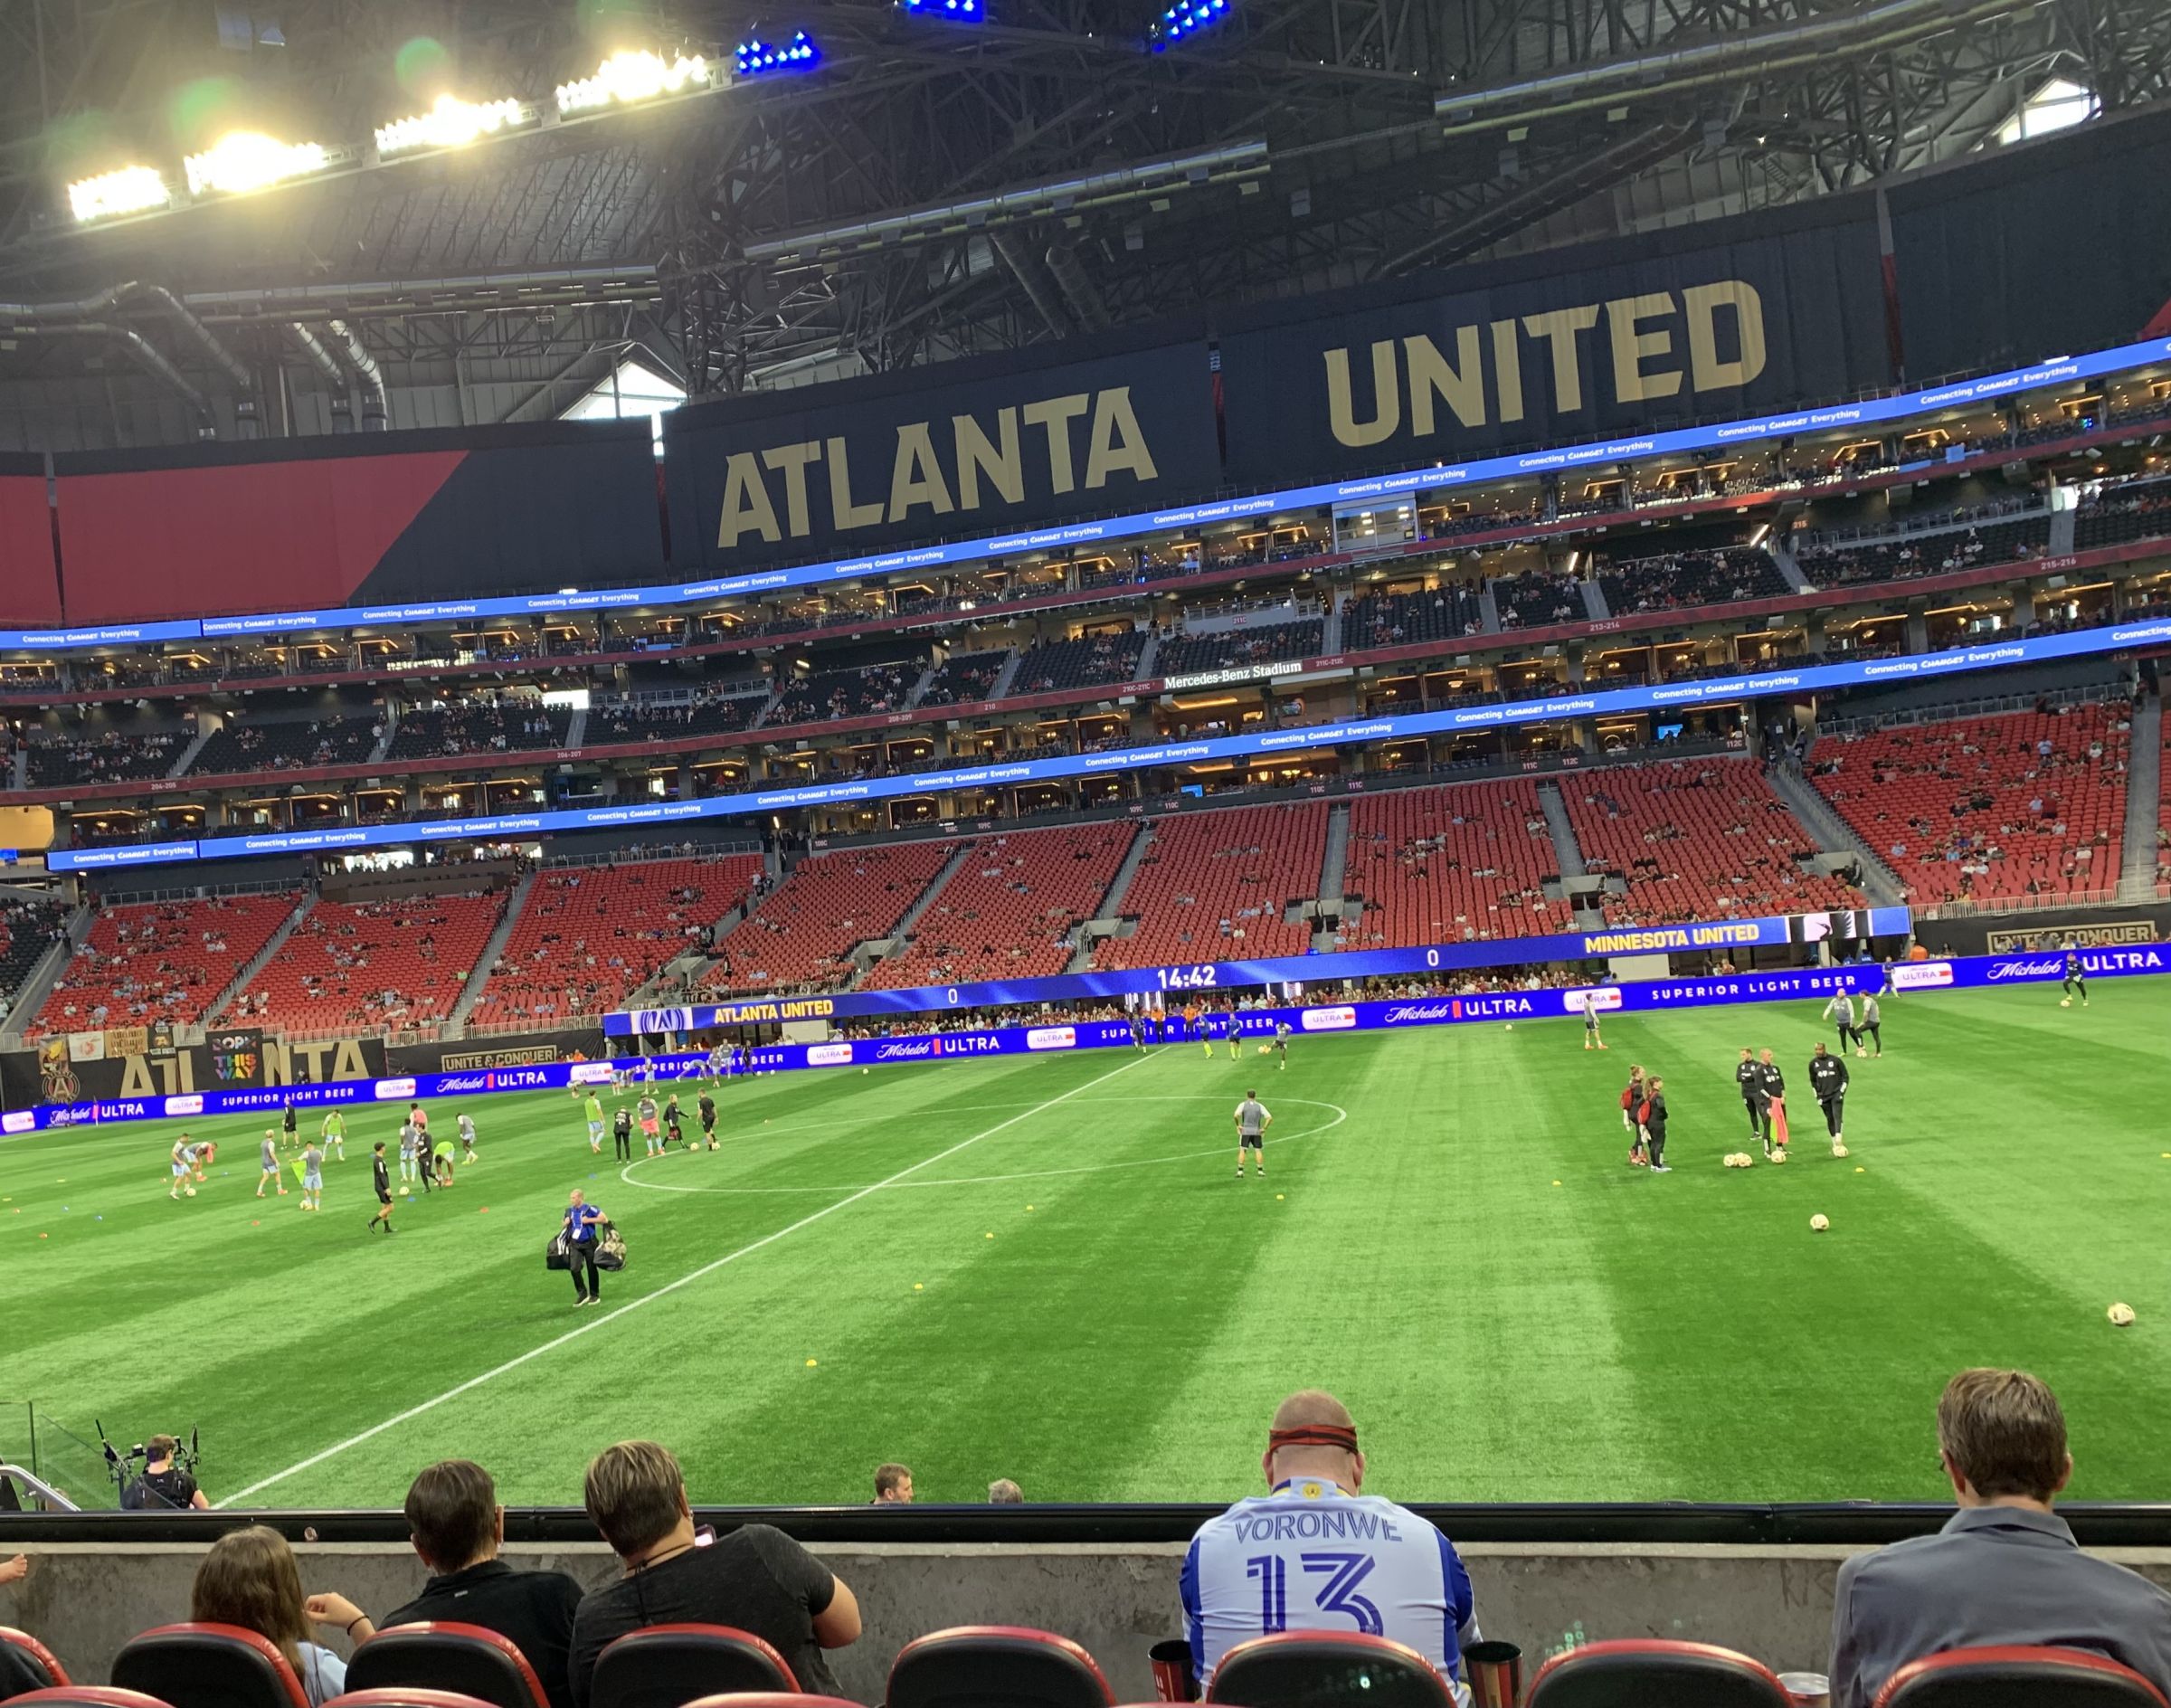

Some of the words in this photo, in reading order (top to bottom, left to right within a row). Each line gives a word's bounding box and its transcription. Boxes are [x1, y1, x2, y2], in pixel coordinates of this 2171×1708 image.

[1920, 387, 1974, 405] Connecting
[1975, 376, 2020, 393] CHANGES
[2022, 365, 2078, 383] Everything
[718, 386, 1159, 548] ATLANTA
[1323, 280, 1767, 447] UNITED
[1717, 423, 1767, 438] Connecting
[1768, 417, 1808, 431] CHANGES
[1810, 409, 1861, 423] Everything
[1519, 454, 1566, 468] Connecting
[1567, 448, 1605, 460] CHANGES
[1607, 441, 1654, 454] Everything
[1338, 482, 1383, 496] Connecting
[1383, 476, 1420, 489] CHANGES
[1422, 470, 1466, 482] Everything
[1153, 512, 1196, 525] Connecting
[1196, 506, 1231, 517] CHANGES
[1232, 499, 1275, 512] Everything
[988, 537, 1029, 550] Connecting
[1029, 532, 1062, 544] CHANGES
[1063, 527, 1104, 538] Everything
[835, 562, 873, 574] Connecting
[874, 556, 905, 568] CHANGES
[906, 551, 944, 563] Everything
[2041, 557, 2077, 570] 215-216
[683, 584, 720, 596] Connecting
[751, 574, 787, 586] Everything
[527, 598, 567, 608] Connecting
[601, 593, 640, 603] Everything
[362, 610, 403, 620] Connecting
[437, 604, 477, 614] Everything
[202, 622, 243, 631] Connecting
[277, 615, 318, 626] Everything
[1589, 622, 1620, 631] 213-214
[22, 635, 65, 644] Connecting
[100, 629, 140, 640] Everything
[1864, 662, 1919, 676] Connecting
[1920, 655, 1966, 669] CHANGES
[1967, 647, 2024, 662] Everything
[1164, 669, 1251, 689] Mercedes-Benz
[1253, 662, 1303, 678] Stadium
[1652, 687, 1703, 700] Connecting
[1704, 682, 1746, 694] CHANGES
[1748, 676, 1799, 689] Everything
[1455, 710, 1503, 723] Connecting
[1504, 705, 1545, 717] CHANGES
[1546, 699, 1595, 712] Everything
[1260, 734, 1306, 746] Connecting
[1307, 729, 1345, 741] CHANGES
[1346, 723, 1393, 736] Everything
[1726, 739, 1743, 748] 112C
[556, 751, 583, 759] 206-207
[1085, 754, 1128, 767] Connecting
[1129, 751, 1164, 762] CHANGES
[1166, 745, 1209, 757] Everything
[1562, 756, 1578, 765] 112C
[1522, 761, 1538, 770] 111C
[914, 775, 954, 787] Connecting
[954, 771, 989, 783] CHANGES
[990, 766, 1030, 778] Everything
[1348, 781, 1363, 790] 111C
[150, 783, 177, 791] 204-205
[756, 794, 796, 805] Connecting
[830, 785, 868, 797] Everything
[1310, 785, 1325, 793] 110C
[587, 811, 629, 821] Connecting
[663, 804, 702, 815] Everything
[1164, 802, 1179, 810] 110C
[421, 824, 463, 835] Connecting
[498, 818, 540, 829] Everything
[245, 839, 289, 849] Connecting
[324, 832, 366, 843] Everything
[72, 852, 116, 863] Connecting
[152, 846, 194, 857] Everything
[1585, 929, 1689, 954] MINNESOTA
[1692, 924, 1759, 945] UNITED
[1427, 949, 1439, 967] 0
[1986, 960, 2063, 980] Michelob
[2083, 952, 2163, 972] ULTRA
[1157, 964, 1217, 989] 14:42
[1902, 971, 1938, 981] ULTRA
[948, 988, 958, 1004] 0
[1652, 984, 1740, 1000] SUPERIOR
[1749, 979, 1801, 993] LIGHT
[1811, 975, 1855, 989] BEER
[714, 1004, 779, 1024] ATLANTA
[781, 999, 833, 1019] UNITED
[1384, 1003, 1448, 1023] Michelob
[1465, 998, 1533, 1016] ULTRA
[1313, 1015, 1342, 1026] ULTRA
[877, 1042, 931, 1059] Michelob
[944, 1036, 1000, 1053] ULTRA
[1037, 1034, 1063, 1043] ULTRA
[213, 1052, 257, 1068] THIS
[445, 1055, 487, 1070] UNITE
[496, 1049, 554, 1067] CONQUER
[752, 1053, 784, 1065] BEER
[816, 1050, 841, 1059] ULTRA
[215, 1065, 256, 1081] WAY
[437, 1075, 485, 1093] Michelob
[498, 1070, 547, 1086] ULTRA
[222, 1093, 280, 1106] SUPERIOR
[325, 1087, 355, 1098] BEER
[100, 1103, 145, 1118] ULTRA
[1235, 1511, 1403, 1544] VORONWE
[1247, 1552, 1384, 1637] 13
